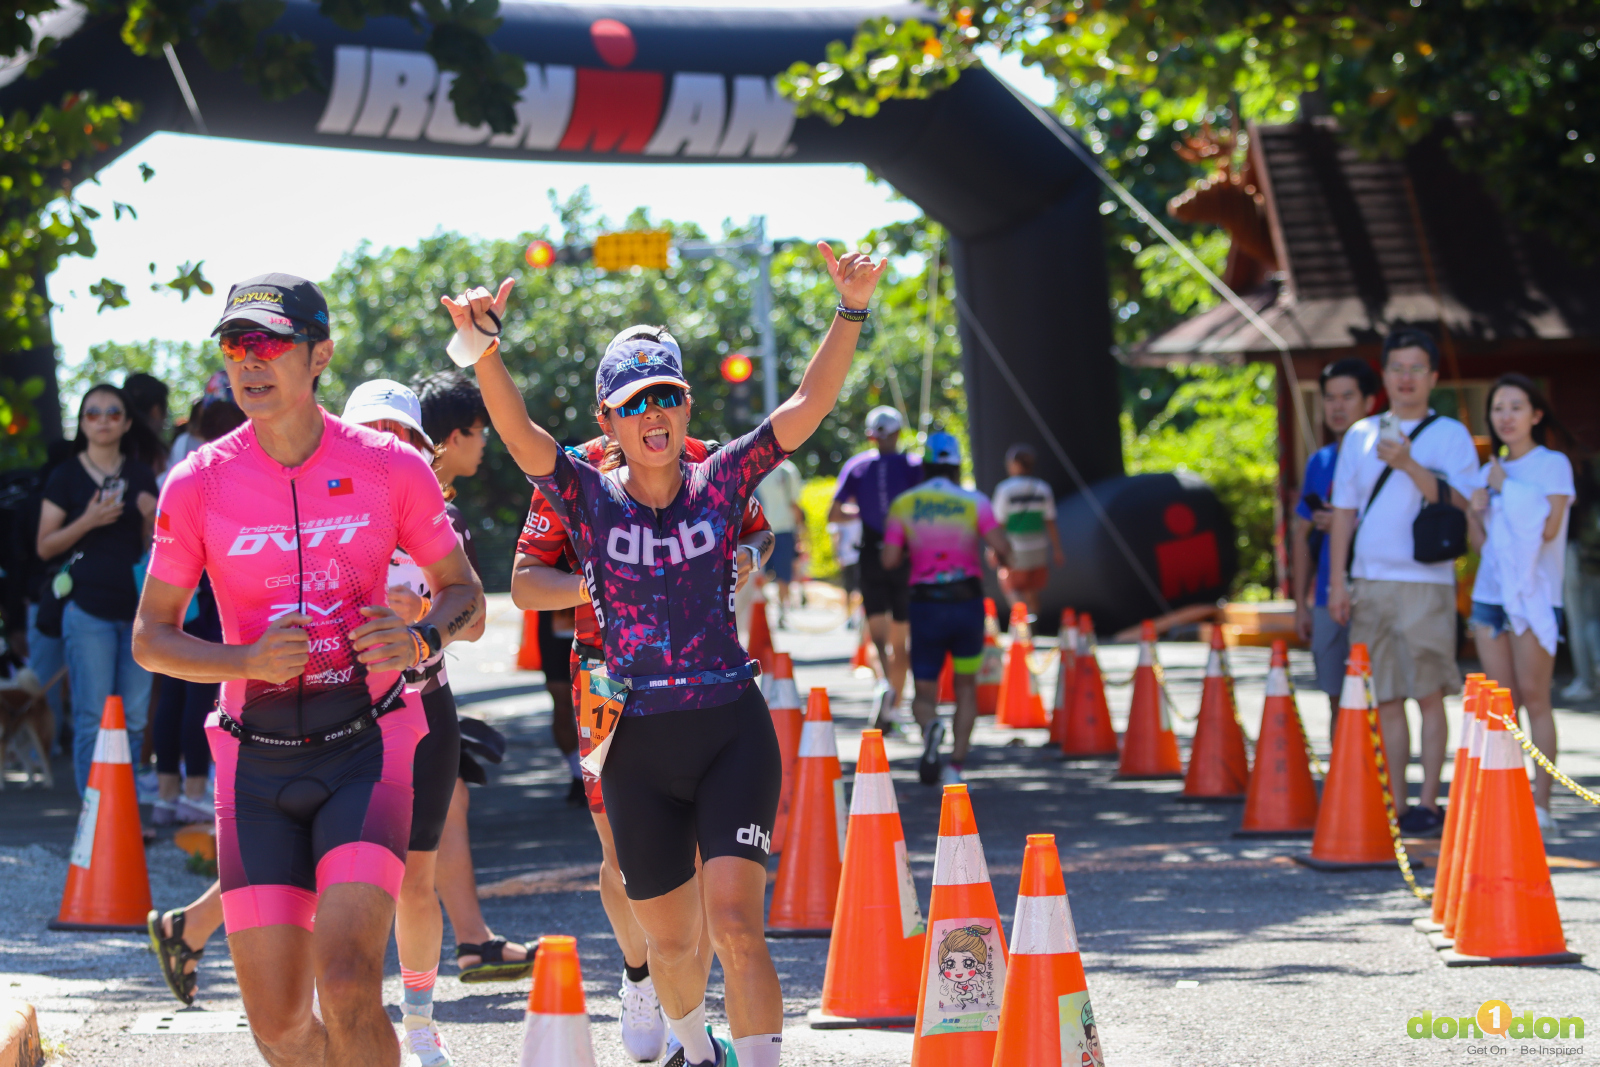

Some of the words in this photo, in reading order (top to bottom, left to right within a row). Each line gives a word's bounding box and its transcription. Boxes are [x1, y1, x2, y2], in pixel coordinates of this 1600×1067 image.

[227, 520, 371, 557] DVTT
[607, 519, 716, 566] dhb
[306, 669, 335, 681] DYNAMIC
[649, 676, 687, 687] IRONMAN
[736, 823, 771, 855] dhb
